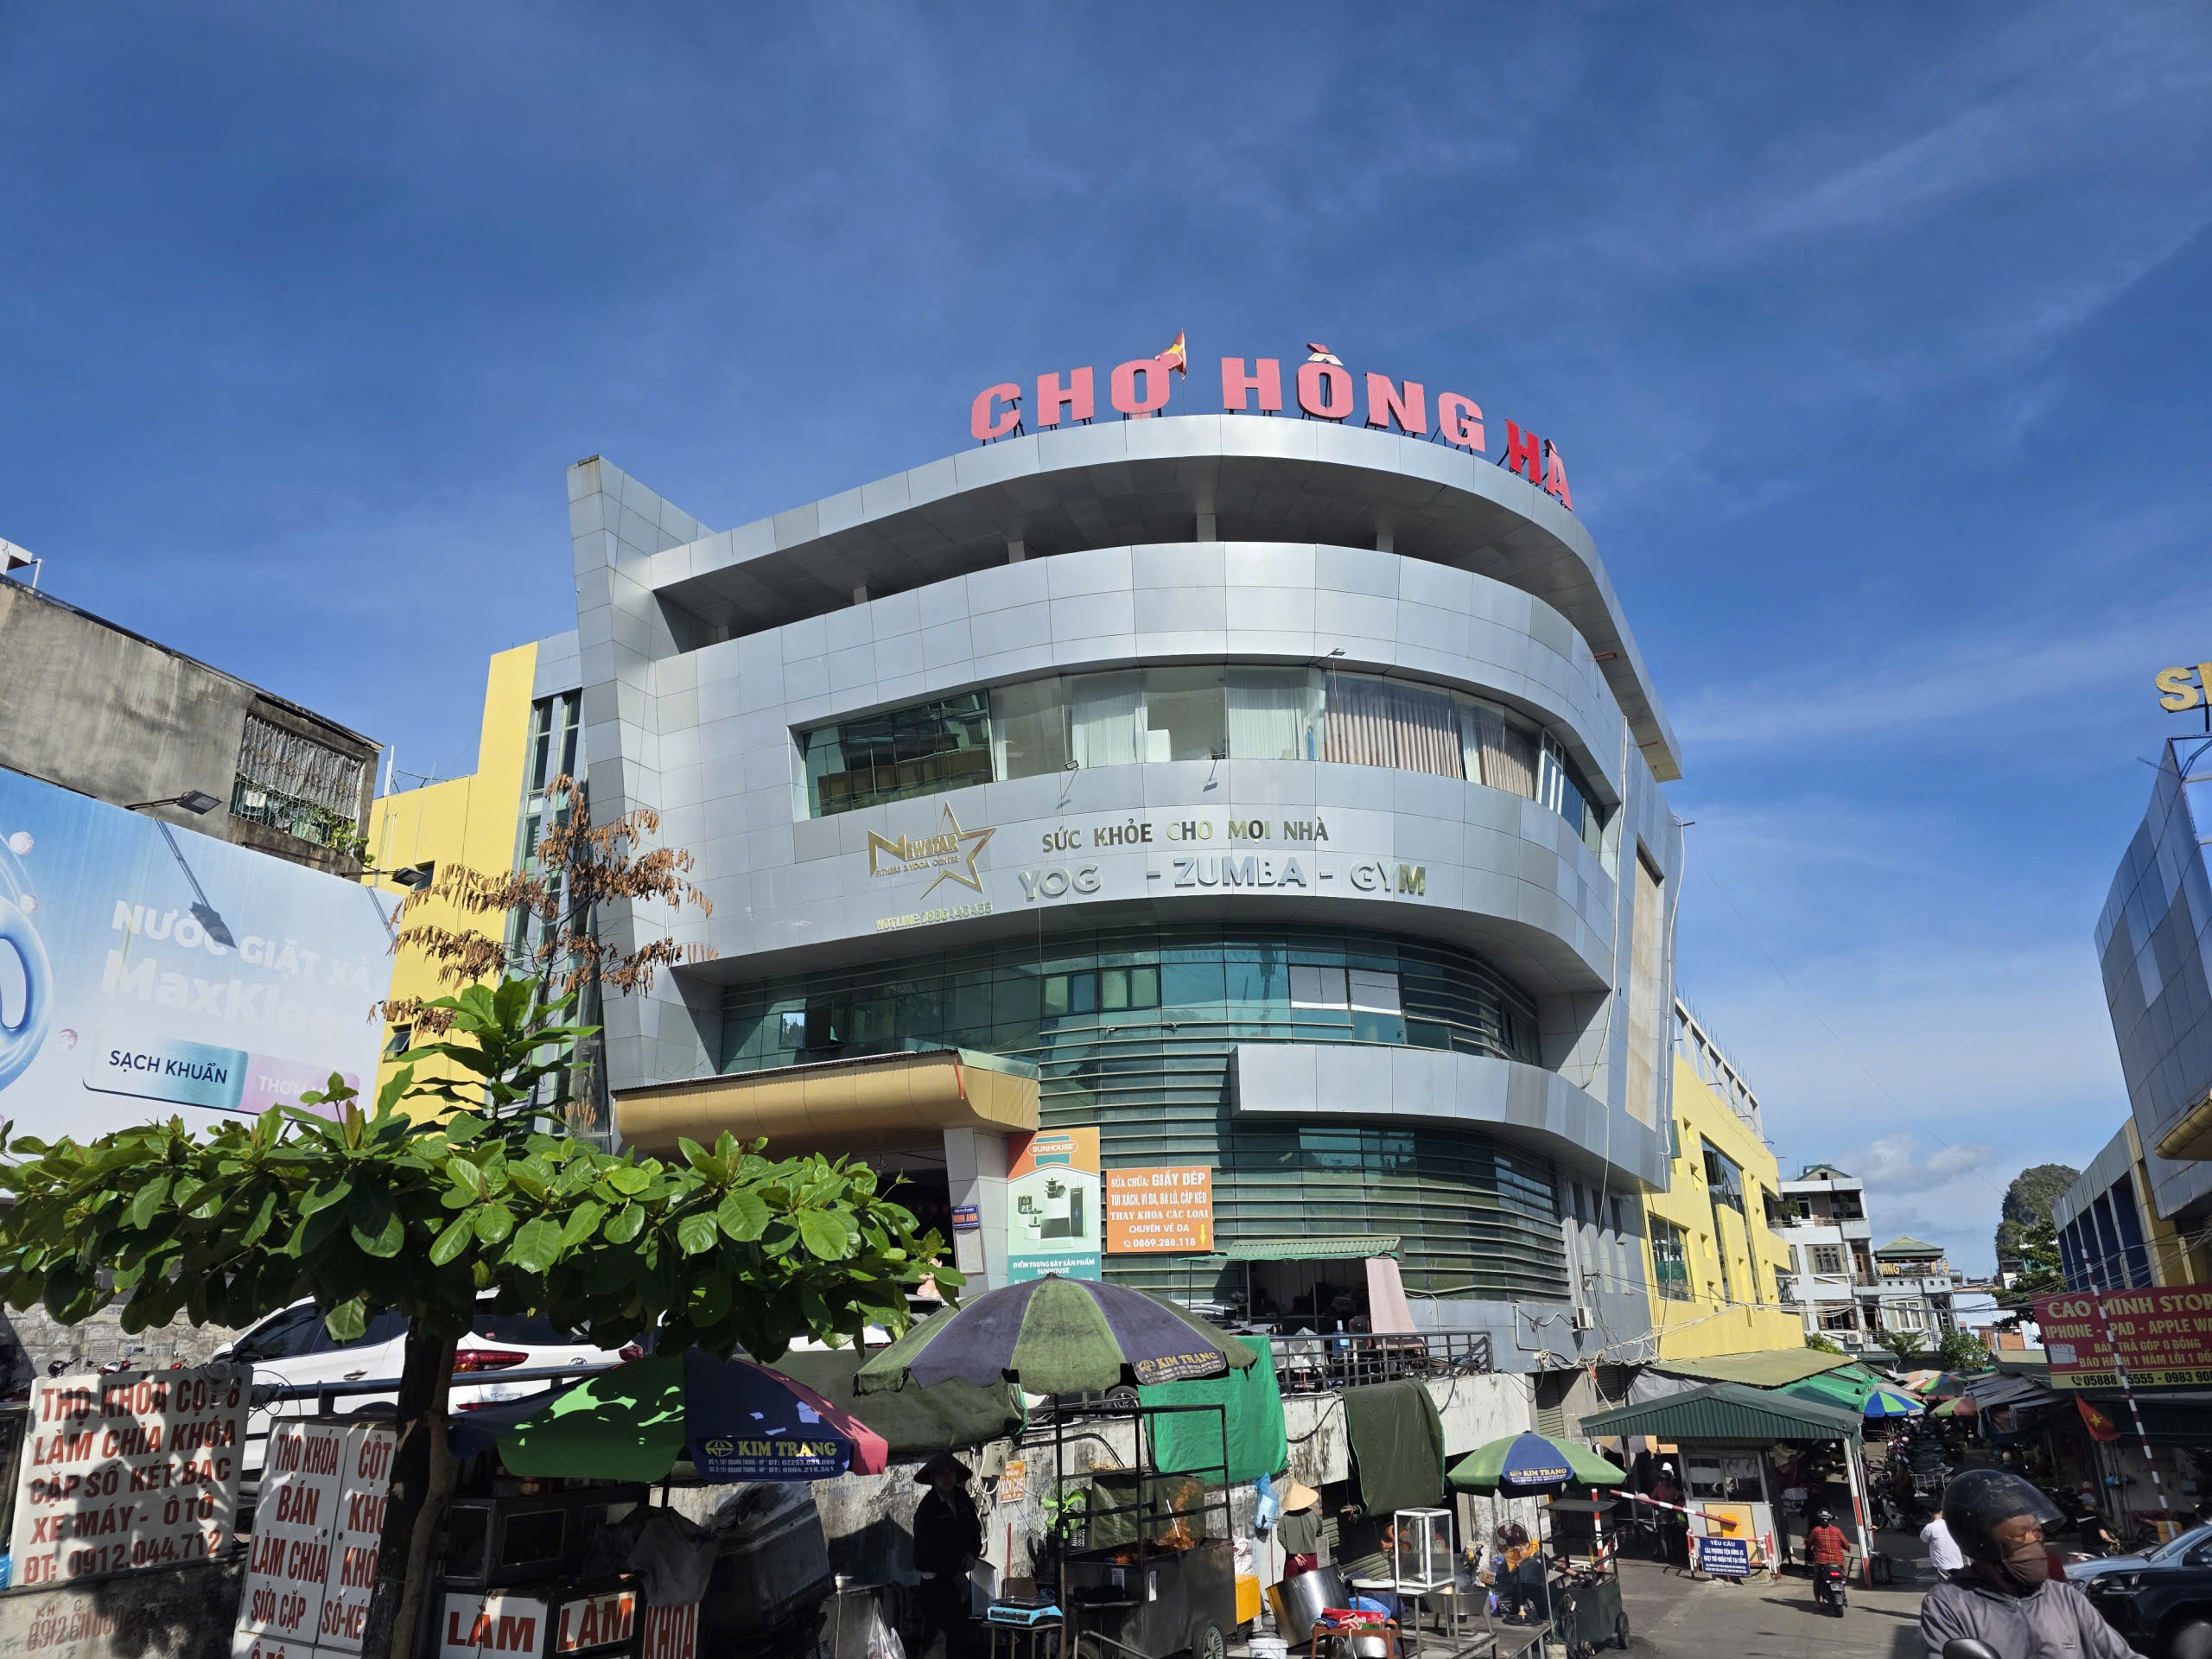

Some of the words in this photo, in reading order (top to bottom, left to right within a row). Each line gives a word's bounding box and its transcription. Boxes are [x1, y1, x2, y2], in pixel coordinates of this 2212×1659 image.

[970, 355, 1179, 440] CHỢ
[1221, 342, 1485, 453] HỒNG
[1505, 418, 1573, 511] HÀ
[1042, 826, 1082, 853] SỨC
[1094, 817, 1154, 847] KHỎE
[1166, 820, 1213, 840] CHO
[1228, 819, 1270, 843] MỌI
[1283, 817, 1329, 841] NHÀ
[932, 855, 959, 867] CENTER
[1018, 864, 1103, 902] YOG
[1173, 856, 1306, 888] ZUMBA
[1351, 860, 1426, 897] GYM
[111, 899, 228, 956] NƯỚC
[239, 935, 321, 980] GIẶT
[109, 1049, 161, 1073] SẠCH
[165, 1058, 228, 1084] KHUẨN
[1032, 1142, 1075, 1154] SUNHOUSE
[1111, 1175, 1126, 1188] SỬA
[1182, 1170, 1206, 1186] DÉP
[1110, 1211, 1135, 1221] THAY
[1166, 1209, 1184, 1219] CÁC
[1186, 1209, 1209, 1220] LOẠI
[1128, 1224, 1160, 1233] CHUYÊN
[1177, 1224, 1189, 1232] DA
[1133, 1237, 1196, 1248] 0869.288.118
[1013, 1259, 1028, 1268] ĐIỂM
[1029, 1259, 1050, 1268] TRƯNG
[1050, 1258, 1062, 1268] BÀY
[1063, 1257, 1076, 1267] SẢN
[1076, 1256, 1095, 1266] PHẨM
[2047, 1300, 2091, 1319] CAO
[2102, 1296, 2155, 1315] MINH
[2044, 1324, 2094, 1339] IPHONE
[2106, 1321, 2136, 1338] PAD
[2148, 1319, 2191, 1335] APPLE
[2139, 1338, 2160, 1351] GÓP
[1155, 1356, 1180, 1370] KIM
[1178, 1351, 1218, 1364] TRANG
[2133, 1356, 2139, 1365] 1
[2187, 1353, 2195, 1363] 1
[2164, 1371, 2193, 1382] 0983
[99, 1372, 168, 1419] KHÓA
[33, 1428, 94, 1466] LÀM
[101, 1421, 162, 1459] CHÌA
[169, 1414, 236, 1452] KHÓA
[737, 1440, 772, 1457] KIM
[775, 1440, 837, 1458] TRANG
[302, 1429, 340, 1476] KHÓA
[359, 1434, 392, 1488] CỘT
[84, 1461, 123, 1498] SỐ
[130, 1459, 175, 1493] KÉT
[181, 1457, 232, 1489] BẠC
[29, 1515, 66, 1545] XE
[74, 1503, 135, 1538] MÁY
[163, 1495, 180, 1526] Ô
[185, 1491, 214, 1522] TÔ
[276, 1480, 321, 1526] BÁN
[347, 1488, 389, 1535] KHÓ
[23, 1554, 57, 1584] ĐT:
[67, 1529, 222, 1579] 0912.044.712
[250, 1529, 287, 1577] LÀM
[288, 1535, 328, 1585] CHÌA
[340, 1541, 378, 1590] KHÓ
[251, 1581, 276, 1625] SỬA
[279, 1589, 307, 1633] CẶP
[447, 1605, 537, 1653] LÀM
[557, 1595, 633, 1652] LÀM
